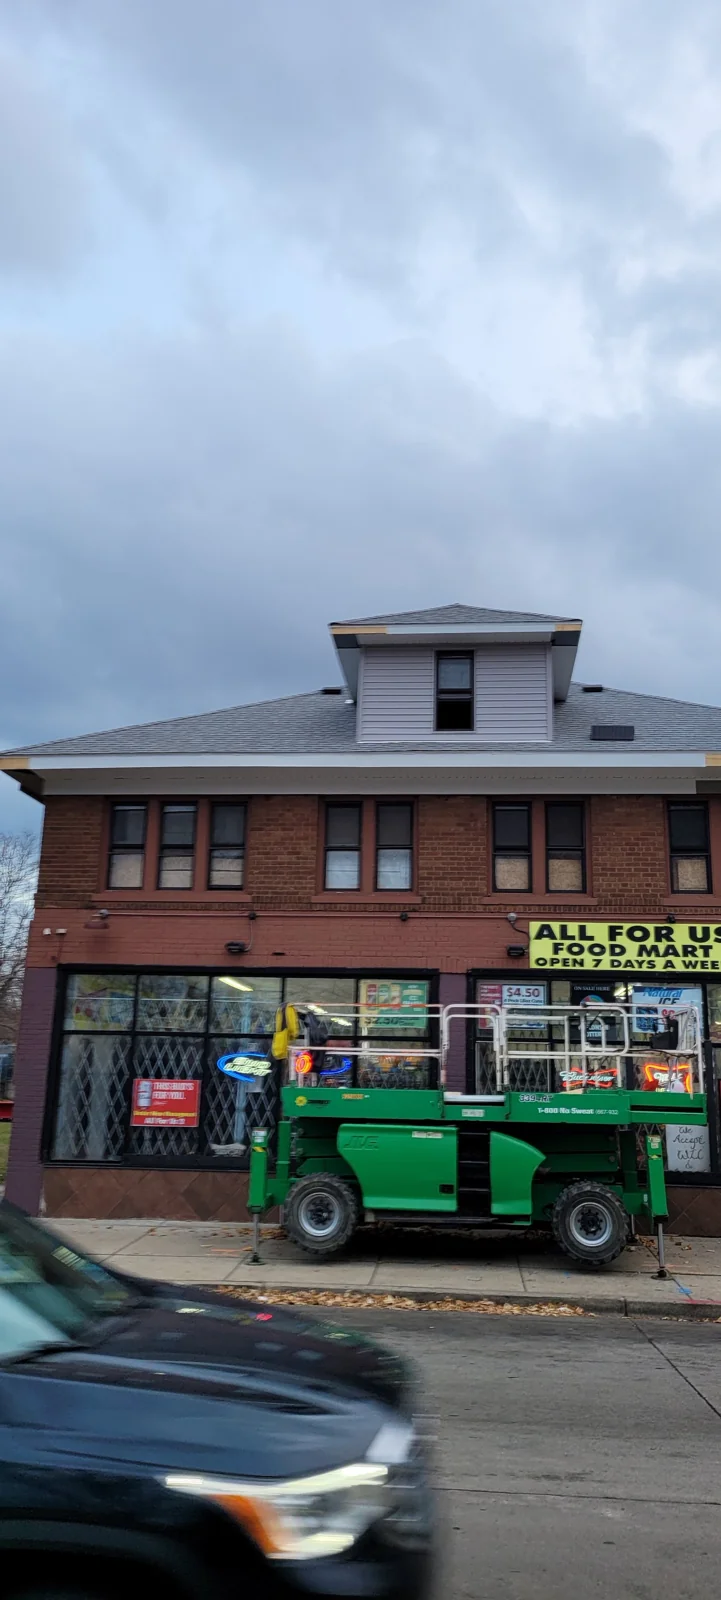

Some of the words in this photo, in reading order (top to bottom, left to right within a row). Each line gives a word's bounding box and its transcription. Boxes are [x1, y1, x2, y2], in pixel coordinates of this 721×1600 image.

[533, 924, 595, 941] ALL
[608, 925, 676, 943] FOR
[552, 943, 627, 956] FOOD
[636, 944, 713, 958] MART
[535, 958, 584, 967] OPEN
[592, 959, 603, 968] 7
[610, 959, 656, 969] DAYS
[662, 960, 676, 970] A
[681, 960, 721, 970] WEE
[506, 987, 540, 998] $4.50
[643, 987, 684, 998] Natural
[571, 1107, 594, 1115] Sweat
[672, 1134, 706, 1150] Accept
